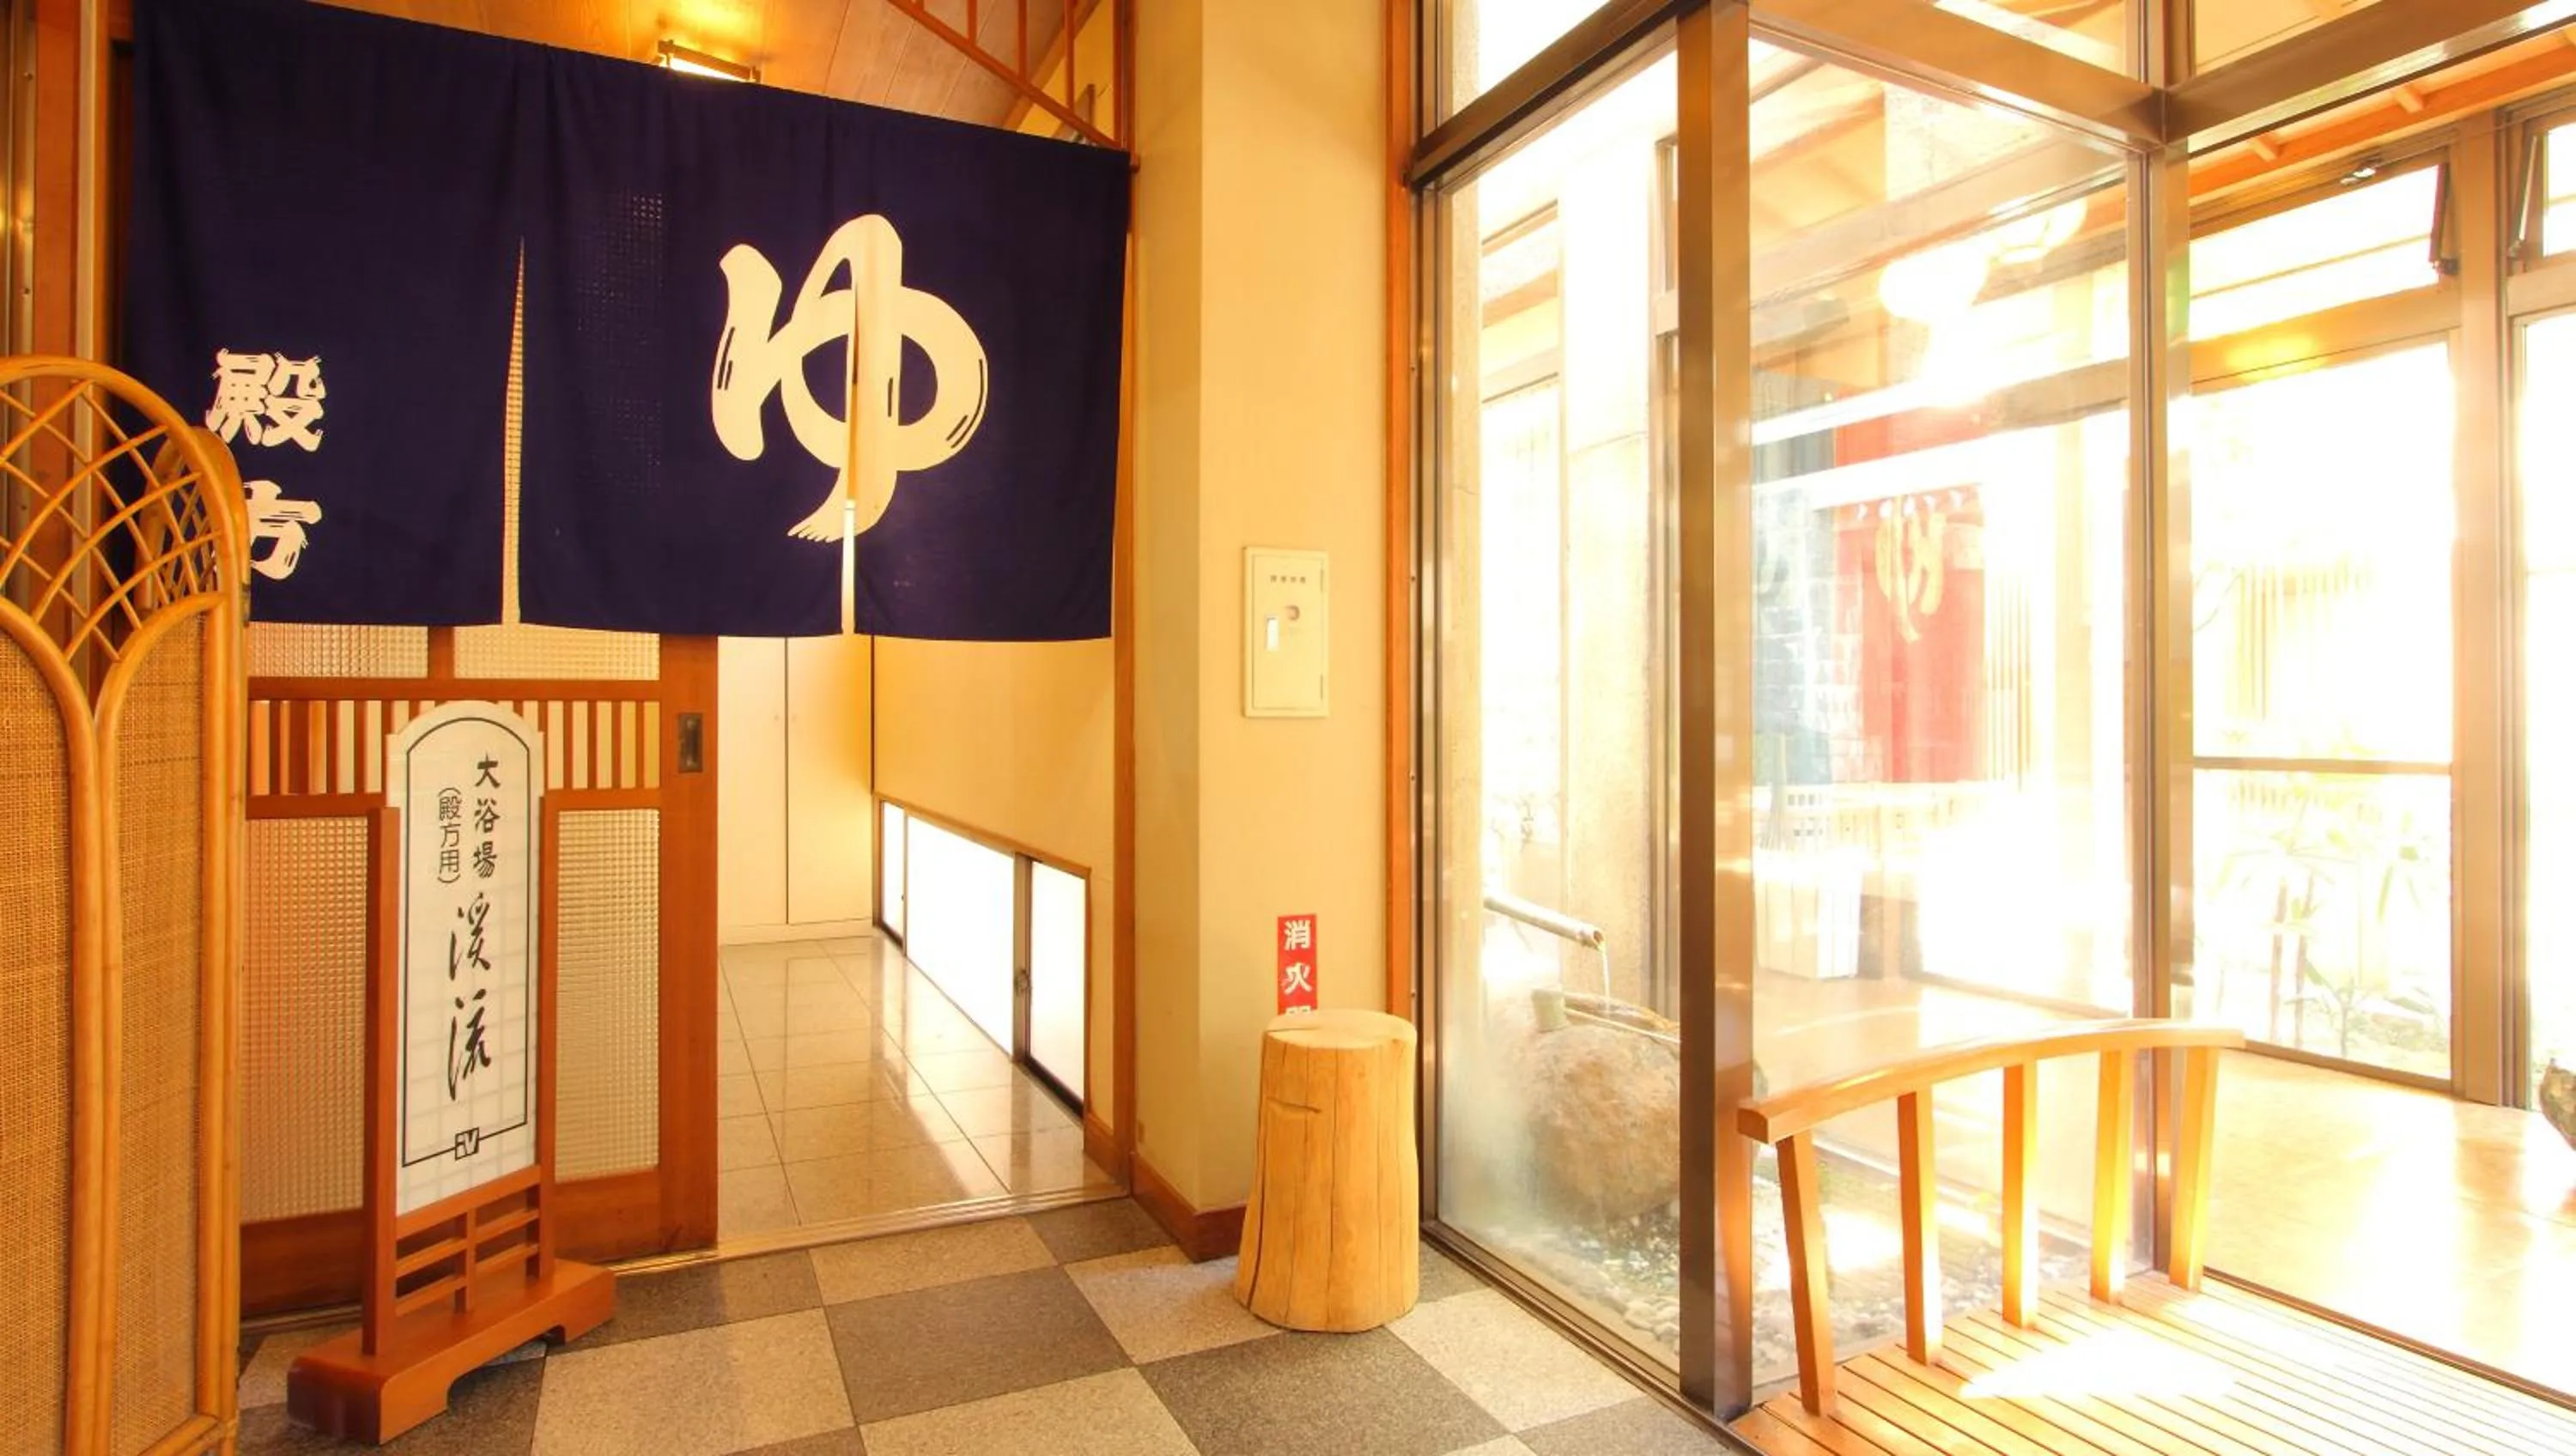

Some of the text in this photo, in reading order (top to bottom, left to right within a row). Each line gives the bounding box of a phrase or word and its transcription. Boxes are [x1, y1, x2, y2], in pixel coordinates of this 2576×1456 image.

[205, 348, 327, 580] 殿方
[712, 214, 988, 543] ゆ
[473, 751, 501, 879] 大浴場
